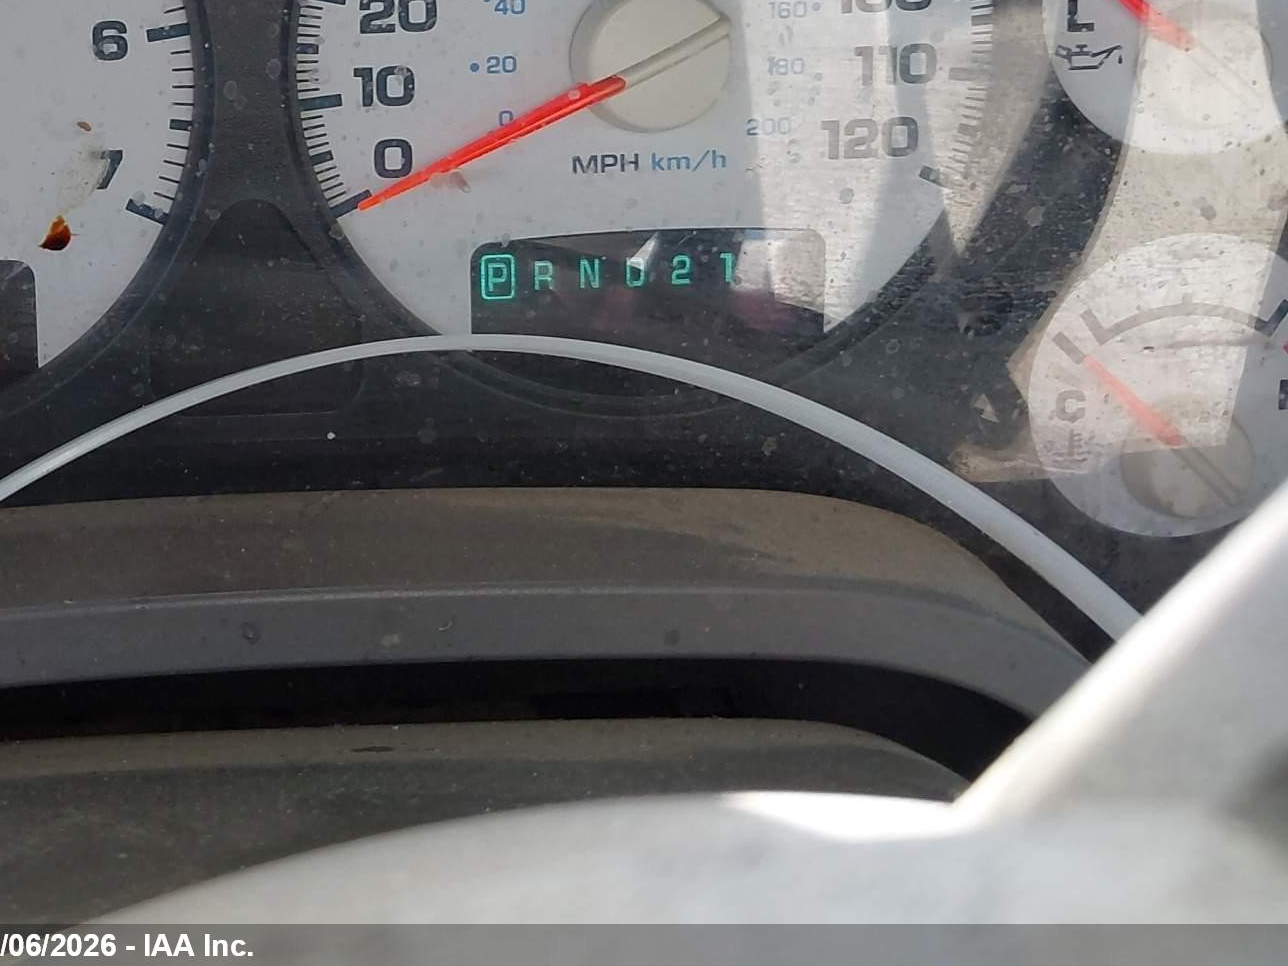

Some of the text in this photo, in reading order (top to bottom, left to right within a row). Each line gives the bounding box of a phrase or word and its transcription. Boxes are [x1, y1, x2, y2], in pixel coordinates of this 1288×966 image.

[769, 1, 807, 18] 160
[1067, 0, 1094, 32] L
[92, 21, 128, 59] 6
[486, 56, 517, 74] 20
[768, 58, 805, 76] 180
[854, 43, 936, 85] 110
[353, 66, 415, 107] 10
[746, 118, 791, 135] 200
[820, 117, 919, 159] 120
[91, 150, 123, 189] 7
[374, 139, 412, 178] 0
[572, 150, 726, 174] MPH km/h
[487, 263, 507, 292] P
[534, 261, 553, 290] R
[579, 259, 599, 288] N
[671, 255, 690, 284] 2
[720, 253, 735, 282] 1
[1056, 390, 1086, 422] C
